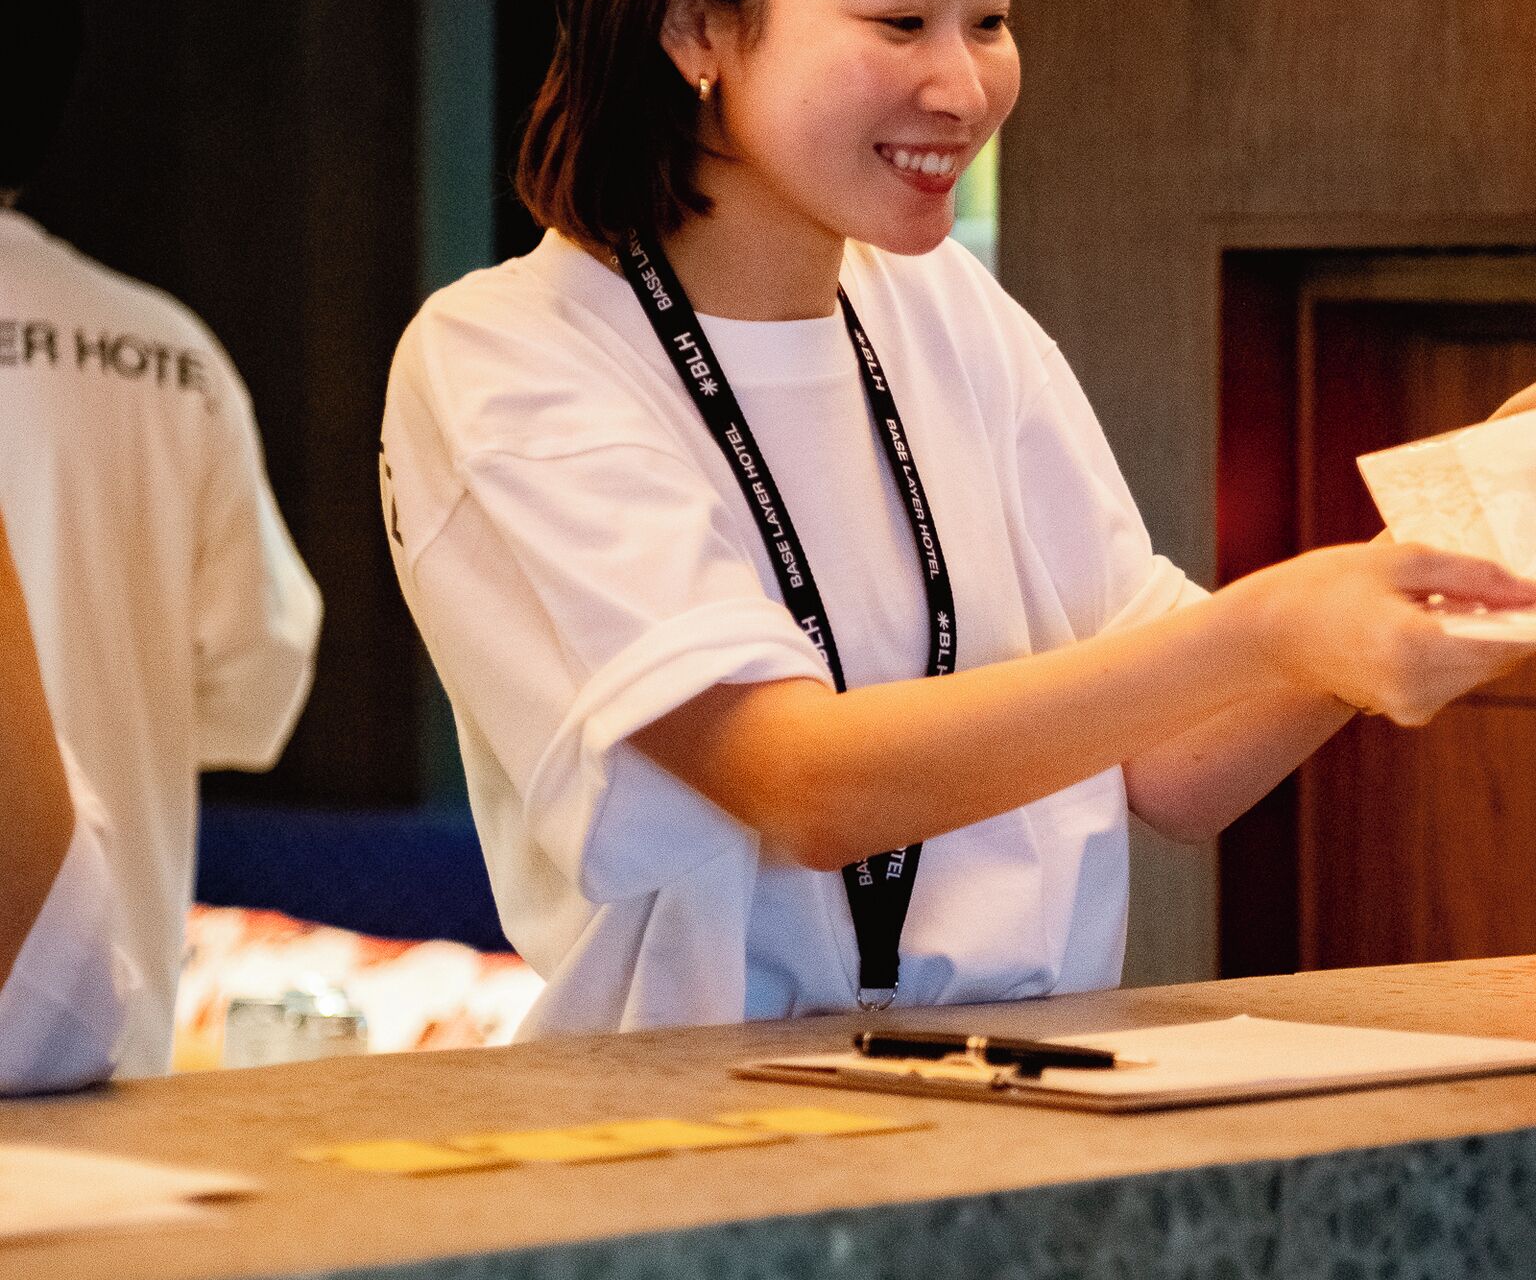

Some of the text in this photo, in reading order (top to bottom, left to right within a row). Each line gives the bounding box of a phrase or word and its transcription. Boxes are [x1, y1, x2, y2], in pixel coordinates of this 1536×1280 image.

[641, 267, 673, 311] BASE
[74, 328, 218, 416] HOTE
[673, 332, 711, 379] BLH
[861, 346, 886, 391] BLH
[725, 422, 804, 588] BASE LAYER HOTEL
[886, 418, 940, 580] BASE LAYER HOTEL
[856, 857, 874, 886] BA
[886, 847, 906, 880] TEL
